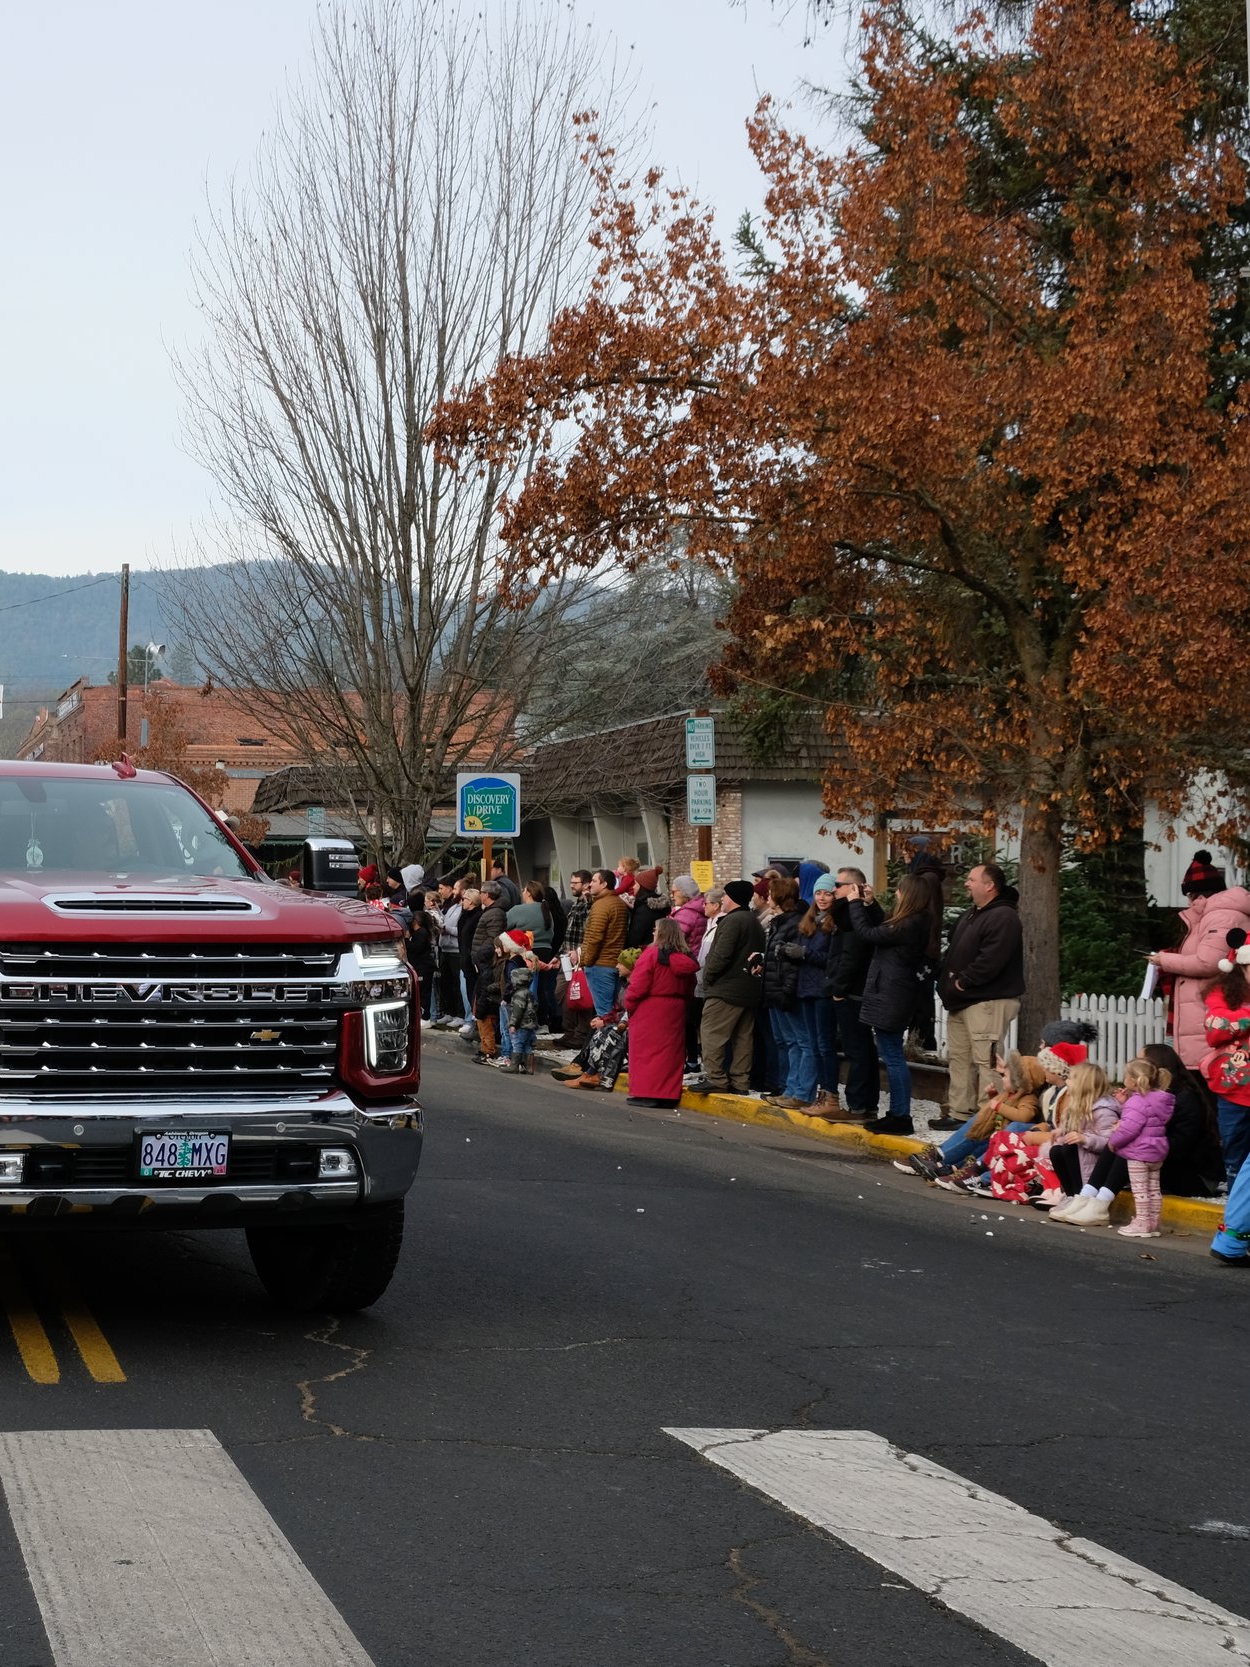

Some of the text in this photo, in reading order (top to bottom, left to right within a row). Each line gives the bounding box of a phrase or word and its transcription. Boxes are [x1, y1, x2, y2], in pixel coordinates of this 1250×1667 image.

[694, 722, 712, 730] PARKING
[467, 794, 510, 805] DISCOVERY
[476, 805, 502, 815] DRIVE
[0, 983, 343, 1002] CHEVROLET
[143, 1142, 226, 1166] 848 MXG
[158, 1170, 175, 1178] TC
[175, 1169, 207, 1178] CHEVY
